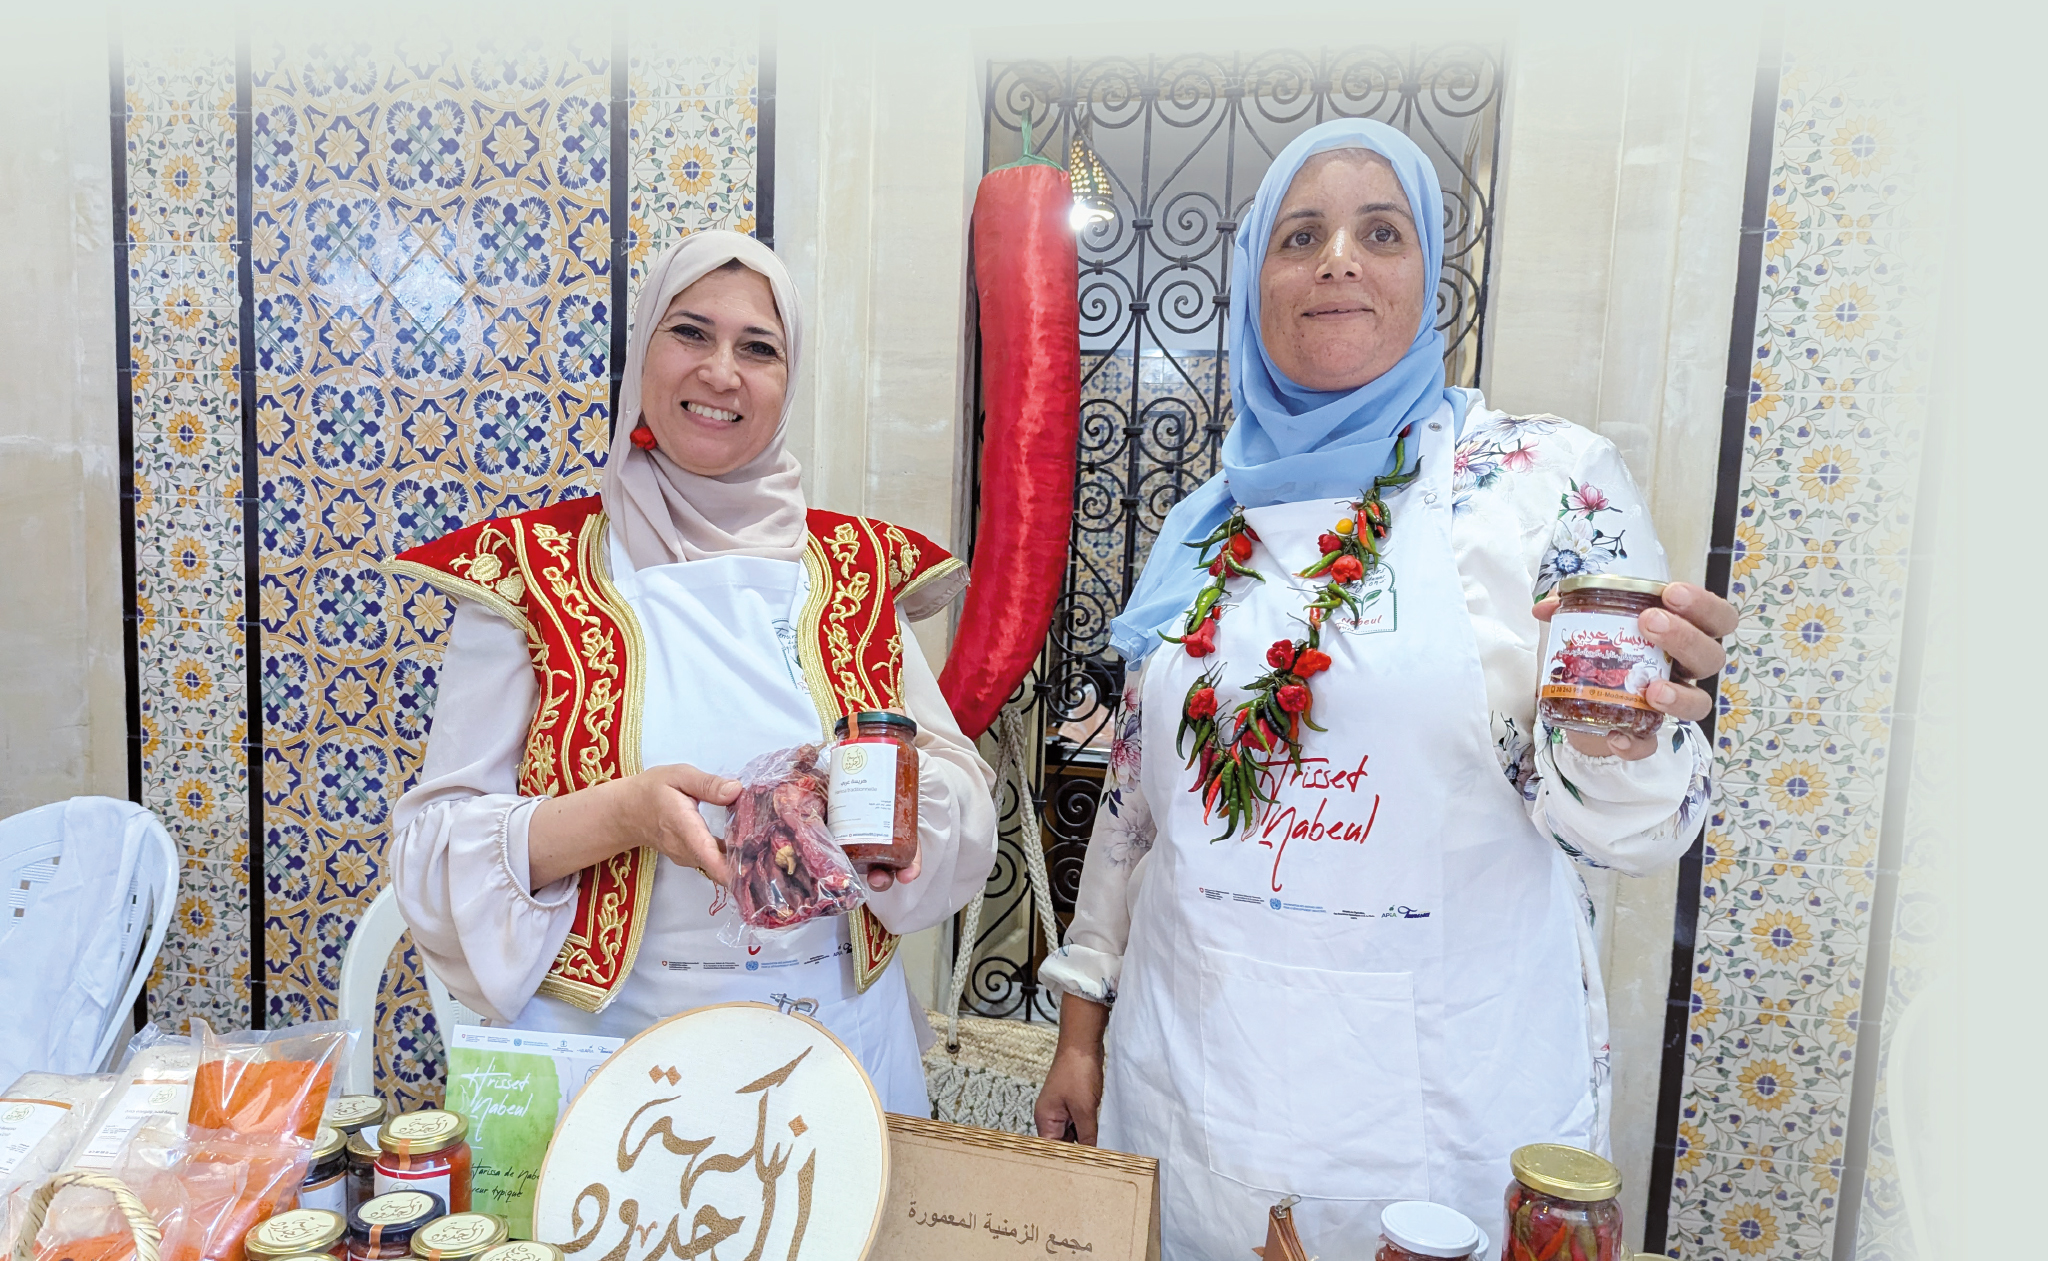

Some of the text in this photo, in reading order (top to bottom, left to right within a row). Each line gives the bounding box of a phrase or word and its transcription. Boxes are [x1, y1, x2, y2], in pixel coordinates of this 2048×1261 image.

[470, 1092, 534, 1142] Nabeul
[504, 1166, 515, 1177] de
[908, 1201, 1093, 1254] مجمع الزمنية المعمورة
